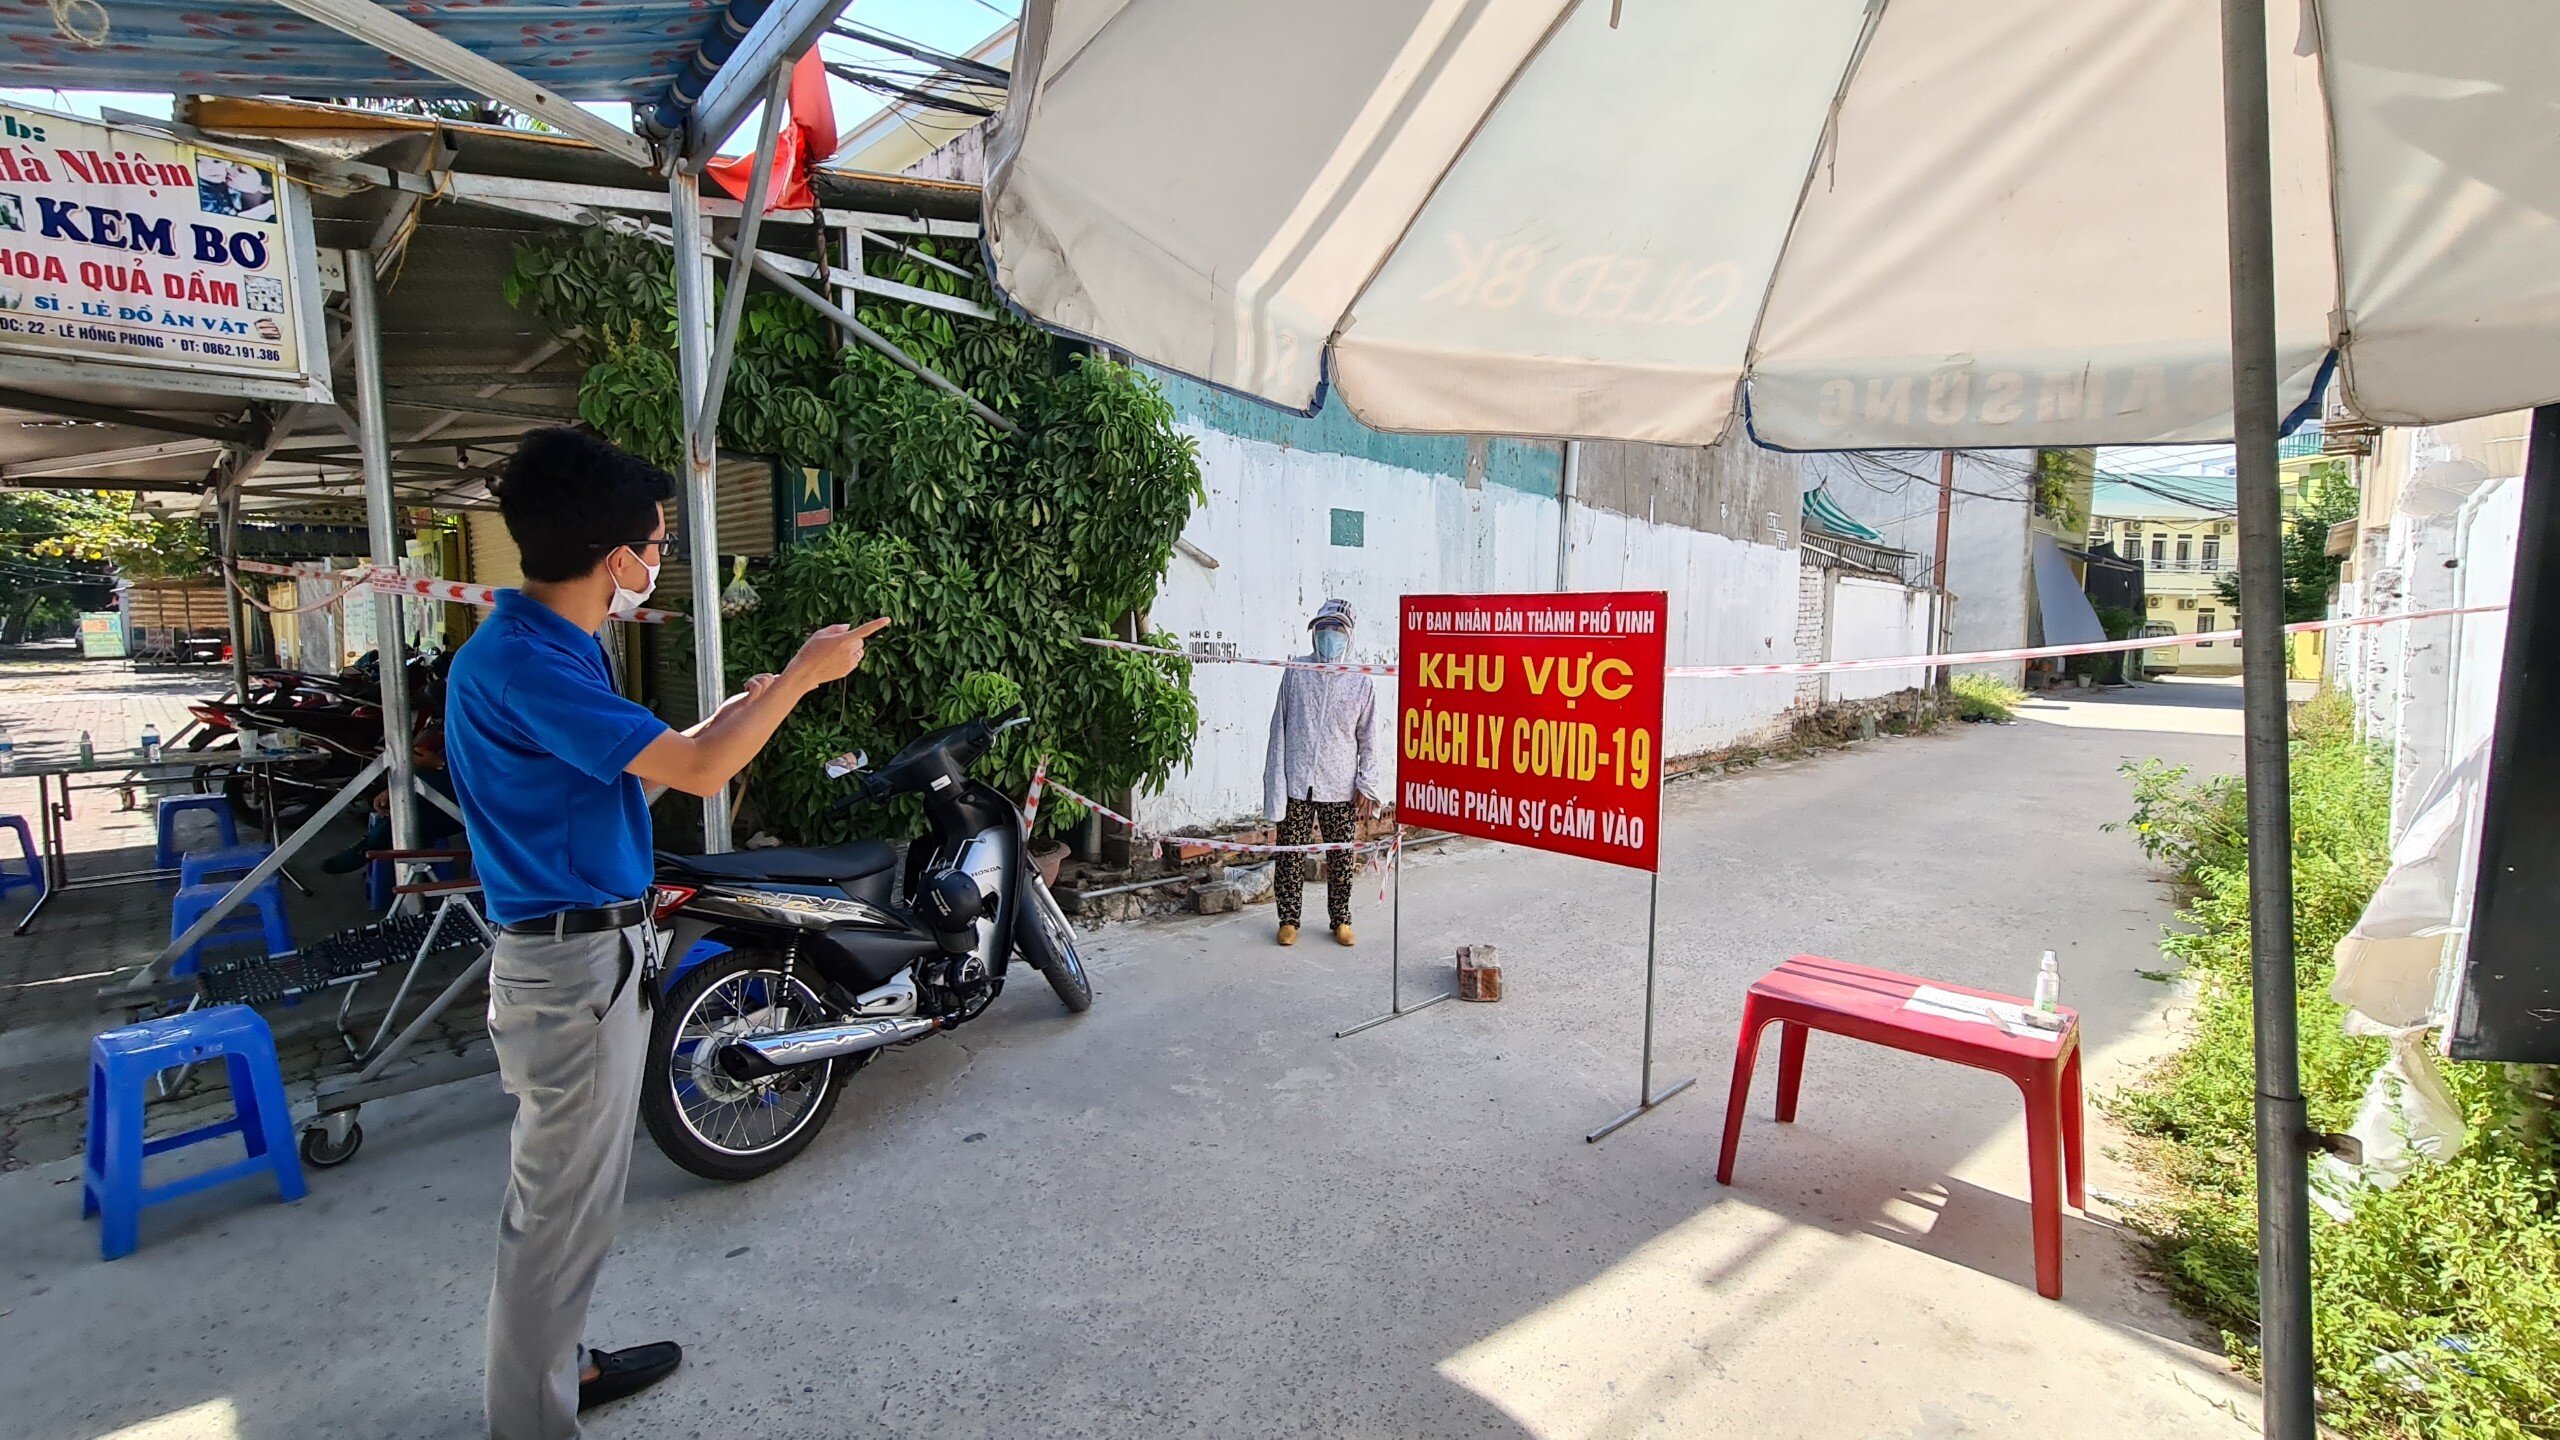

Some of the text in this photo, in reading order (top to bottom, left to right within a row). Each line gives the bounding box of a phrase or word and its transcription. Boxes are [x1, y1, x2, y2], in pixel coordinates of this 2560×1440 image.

[54, 148, 195, 198] Nhiệm
[36, 197, 268, 270] KEM BƠ
[80, 258, 153, 296] QUẢ
[163, 269, 239, 308] DẦM
[28, 320, 46, 335] 22
[59, 323, 76, 339] LÊ
[120, 332, 164, 349] PHONG
[202, 342, 281, 362] 0862.191.386
[161, 309, 195, 328] ĂN
[1408, 602, 1655, 634] ỦY BAN NHÂN DÂN THÀNH PHỐ VINH
[1419, 651, 1634, 709] KHU VỰC
[1404, 698, 1650, 790] CÁCH LY COVID-19
[1405, 779, 1644, 849] KHÔNG PHẬN SỰ CẤM VÀO
[971, 865, 1002, 877] HONDA
